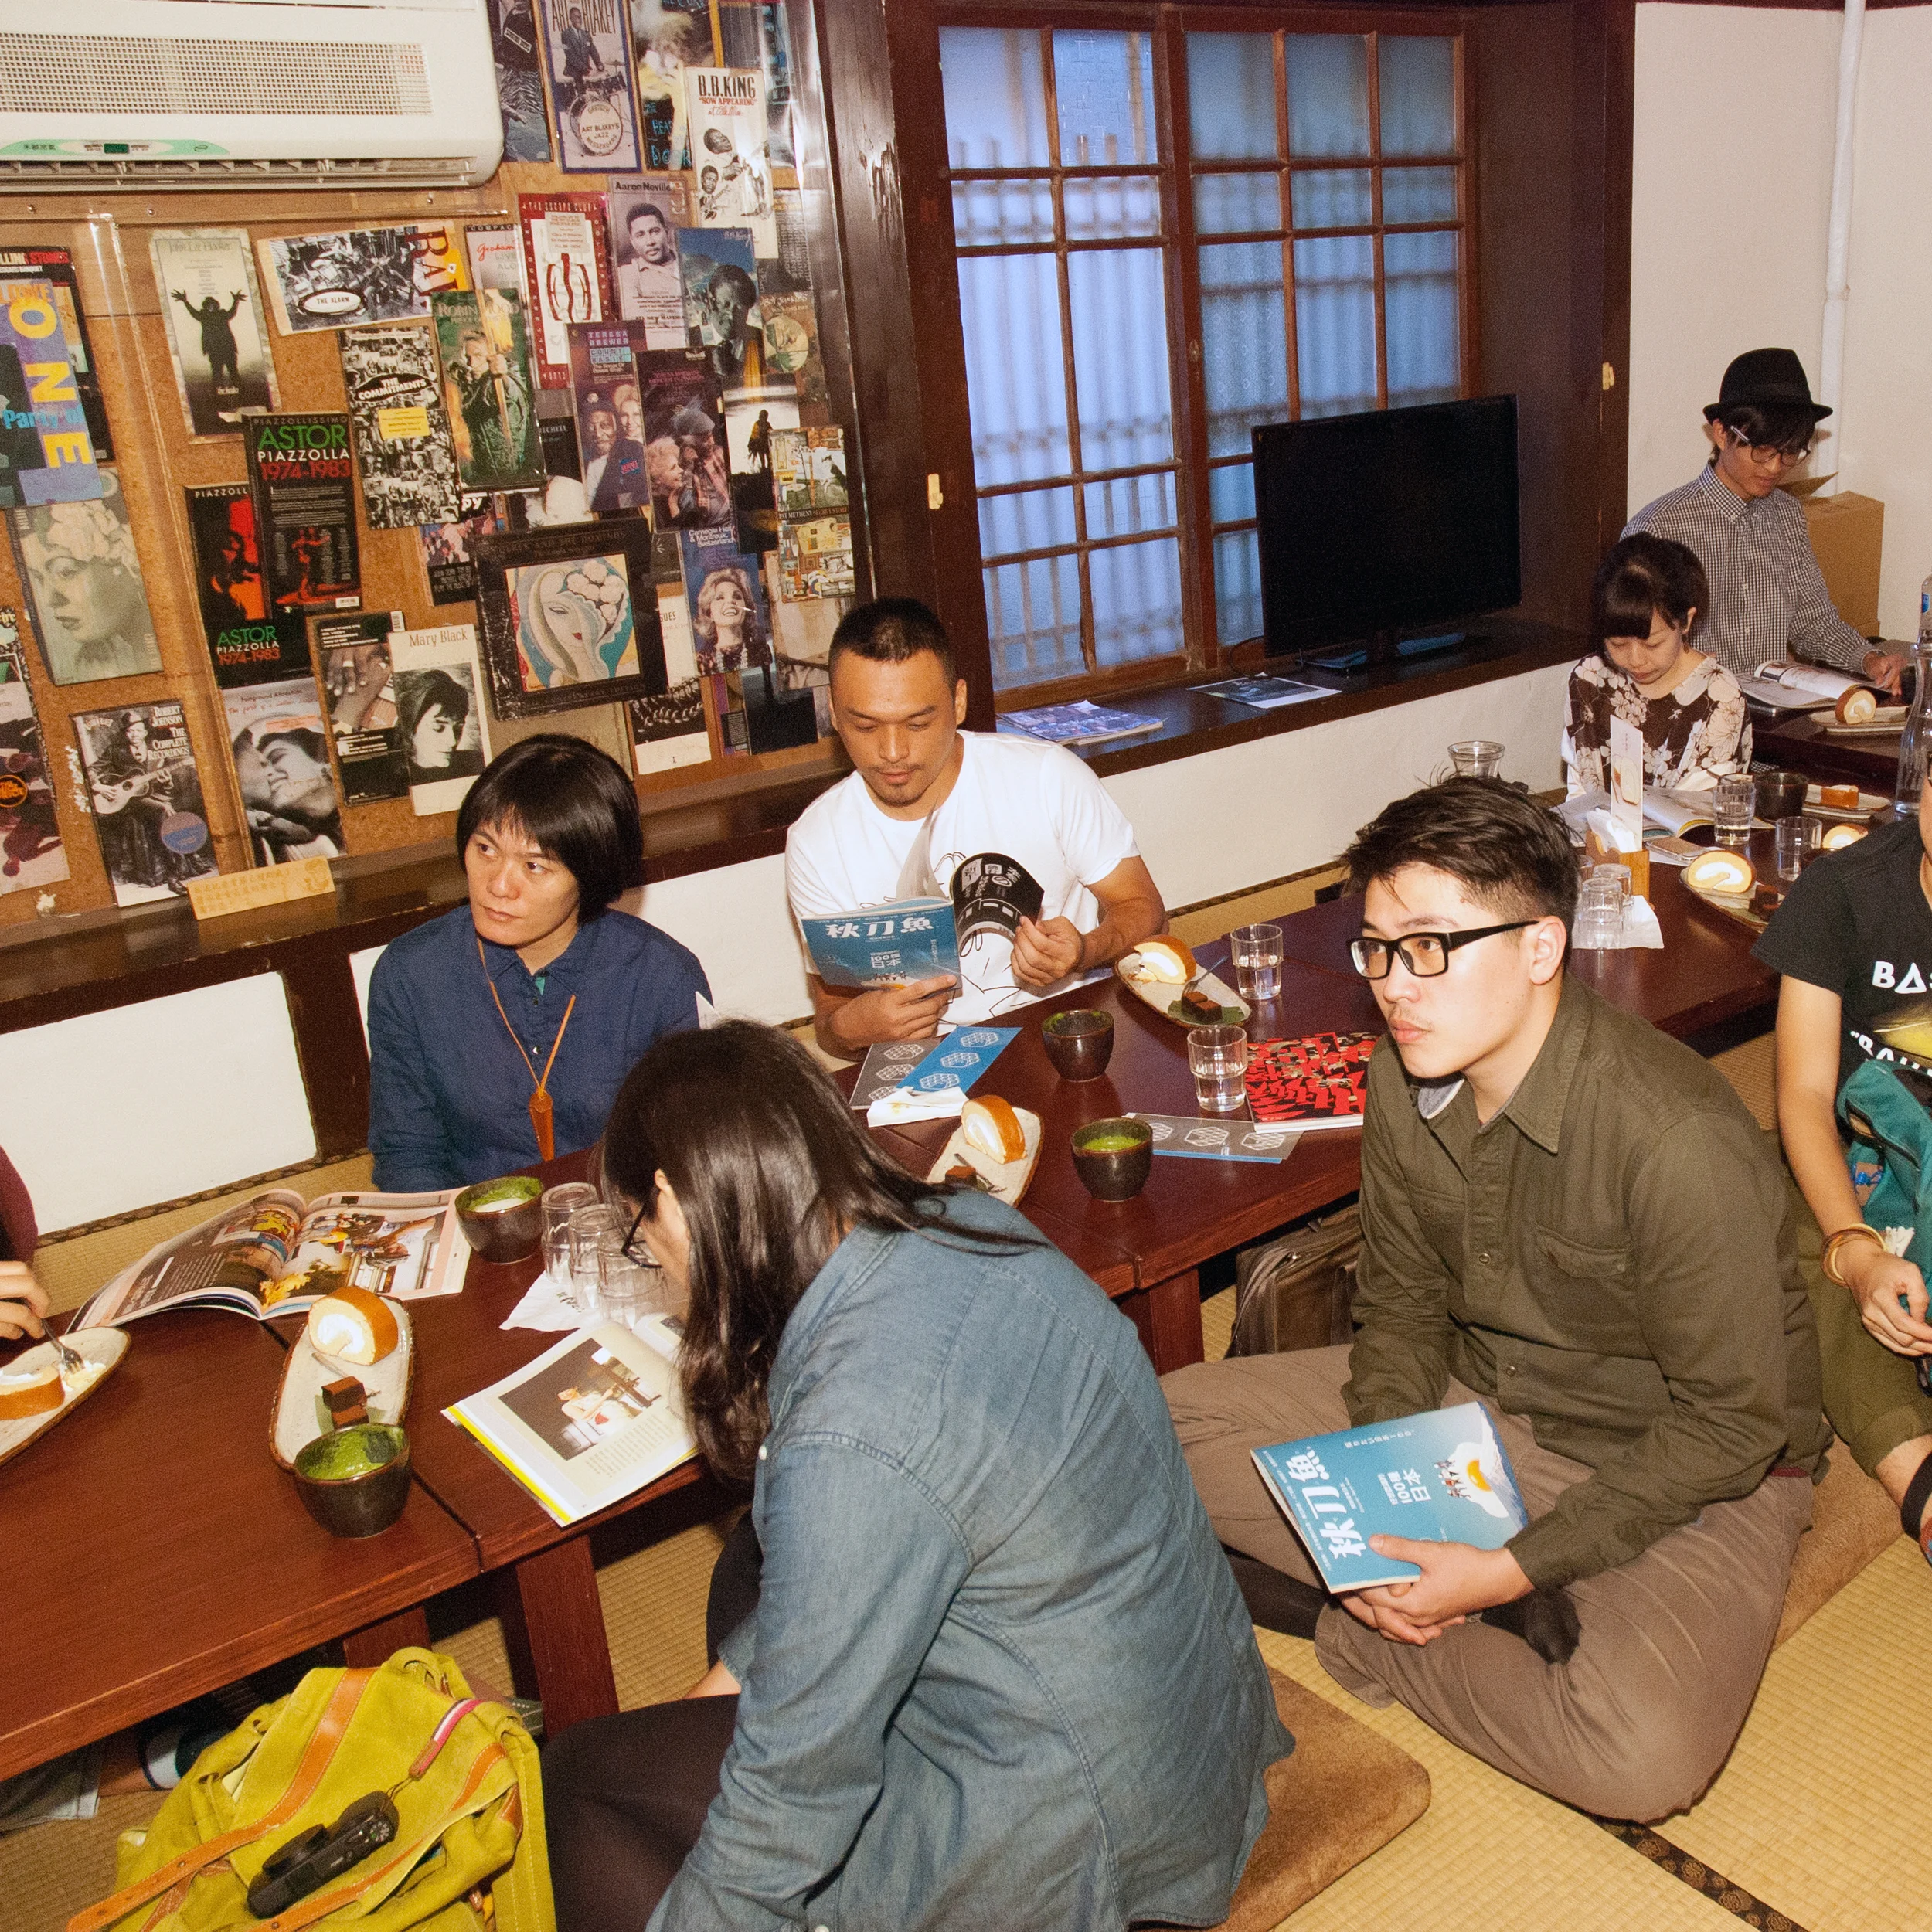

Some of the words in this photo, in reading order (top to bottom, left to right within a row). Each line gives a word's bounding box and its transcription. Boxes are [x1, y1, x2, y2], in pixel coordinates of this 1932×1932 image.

[698, 74, 757, 99] B.B.KING
[615, 182, 642, 191] Aaron
[643, 182, 672, 192] Neville
[358, 378, 427, 400] COMMITMENTS
[380, 377, 400, 386] THE
[257, 423, 347, 451] ASTOR
[257, 448, 351, 463] PIAZZOLLA
[260, 460, 352, 481] 1974-1983
[217, 624, 278, 647] ASTOR
[409, 633, 437, 648] Mary
[440, 628, 468, 644] Black
[216, 640, 280, 655] PIAZZOLLA
[825, 916, 934, 939] 秋刀魚
[872, 959, 902, 969] 日本
[1403, 1468, 1432, 1502] 日本
[1285, 1447, 1367, 1560] 秋刀魚
